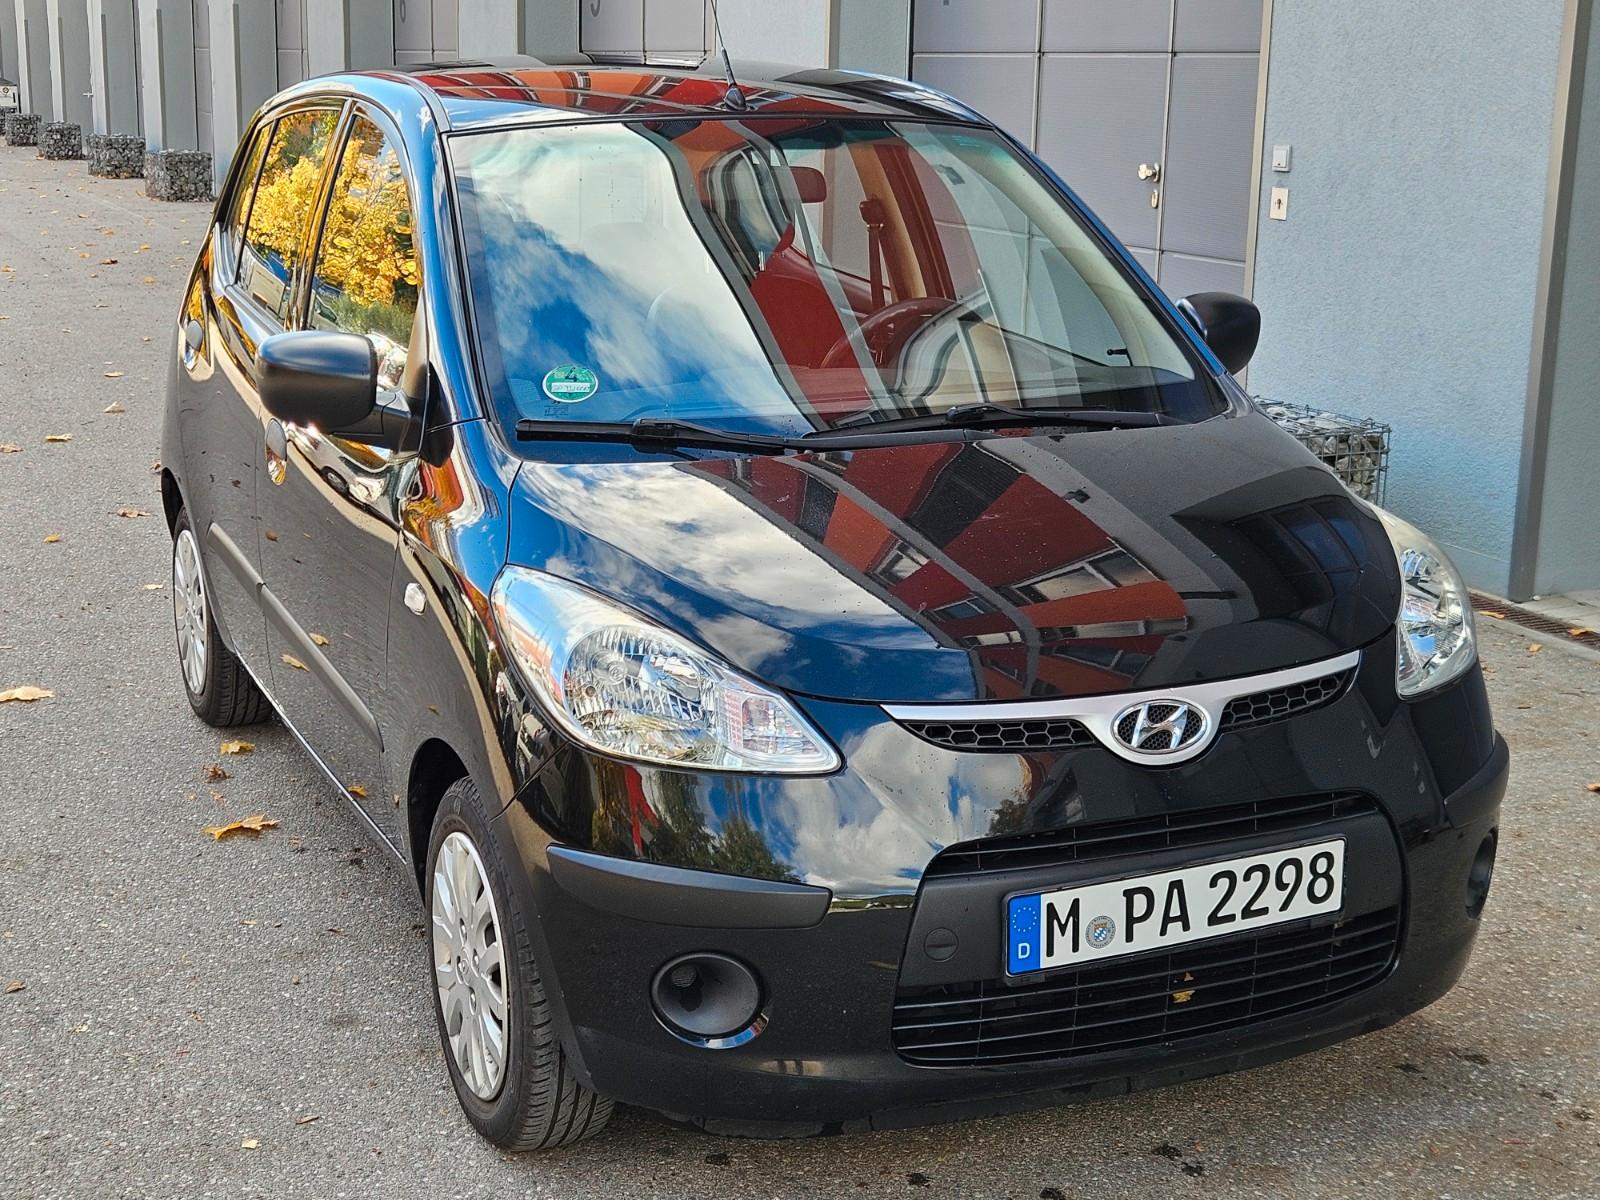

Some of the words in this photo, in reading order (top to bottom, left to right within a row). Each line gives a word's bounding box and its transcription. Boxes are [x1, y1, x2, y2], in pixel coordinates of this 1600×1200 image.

[1046, 898, 1080, 957] M
[1122, 879, 1191, 943] PA
[1207, 851, 1335, 927] 2298
[1018, 943, 1030, 959] D
